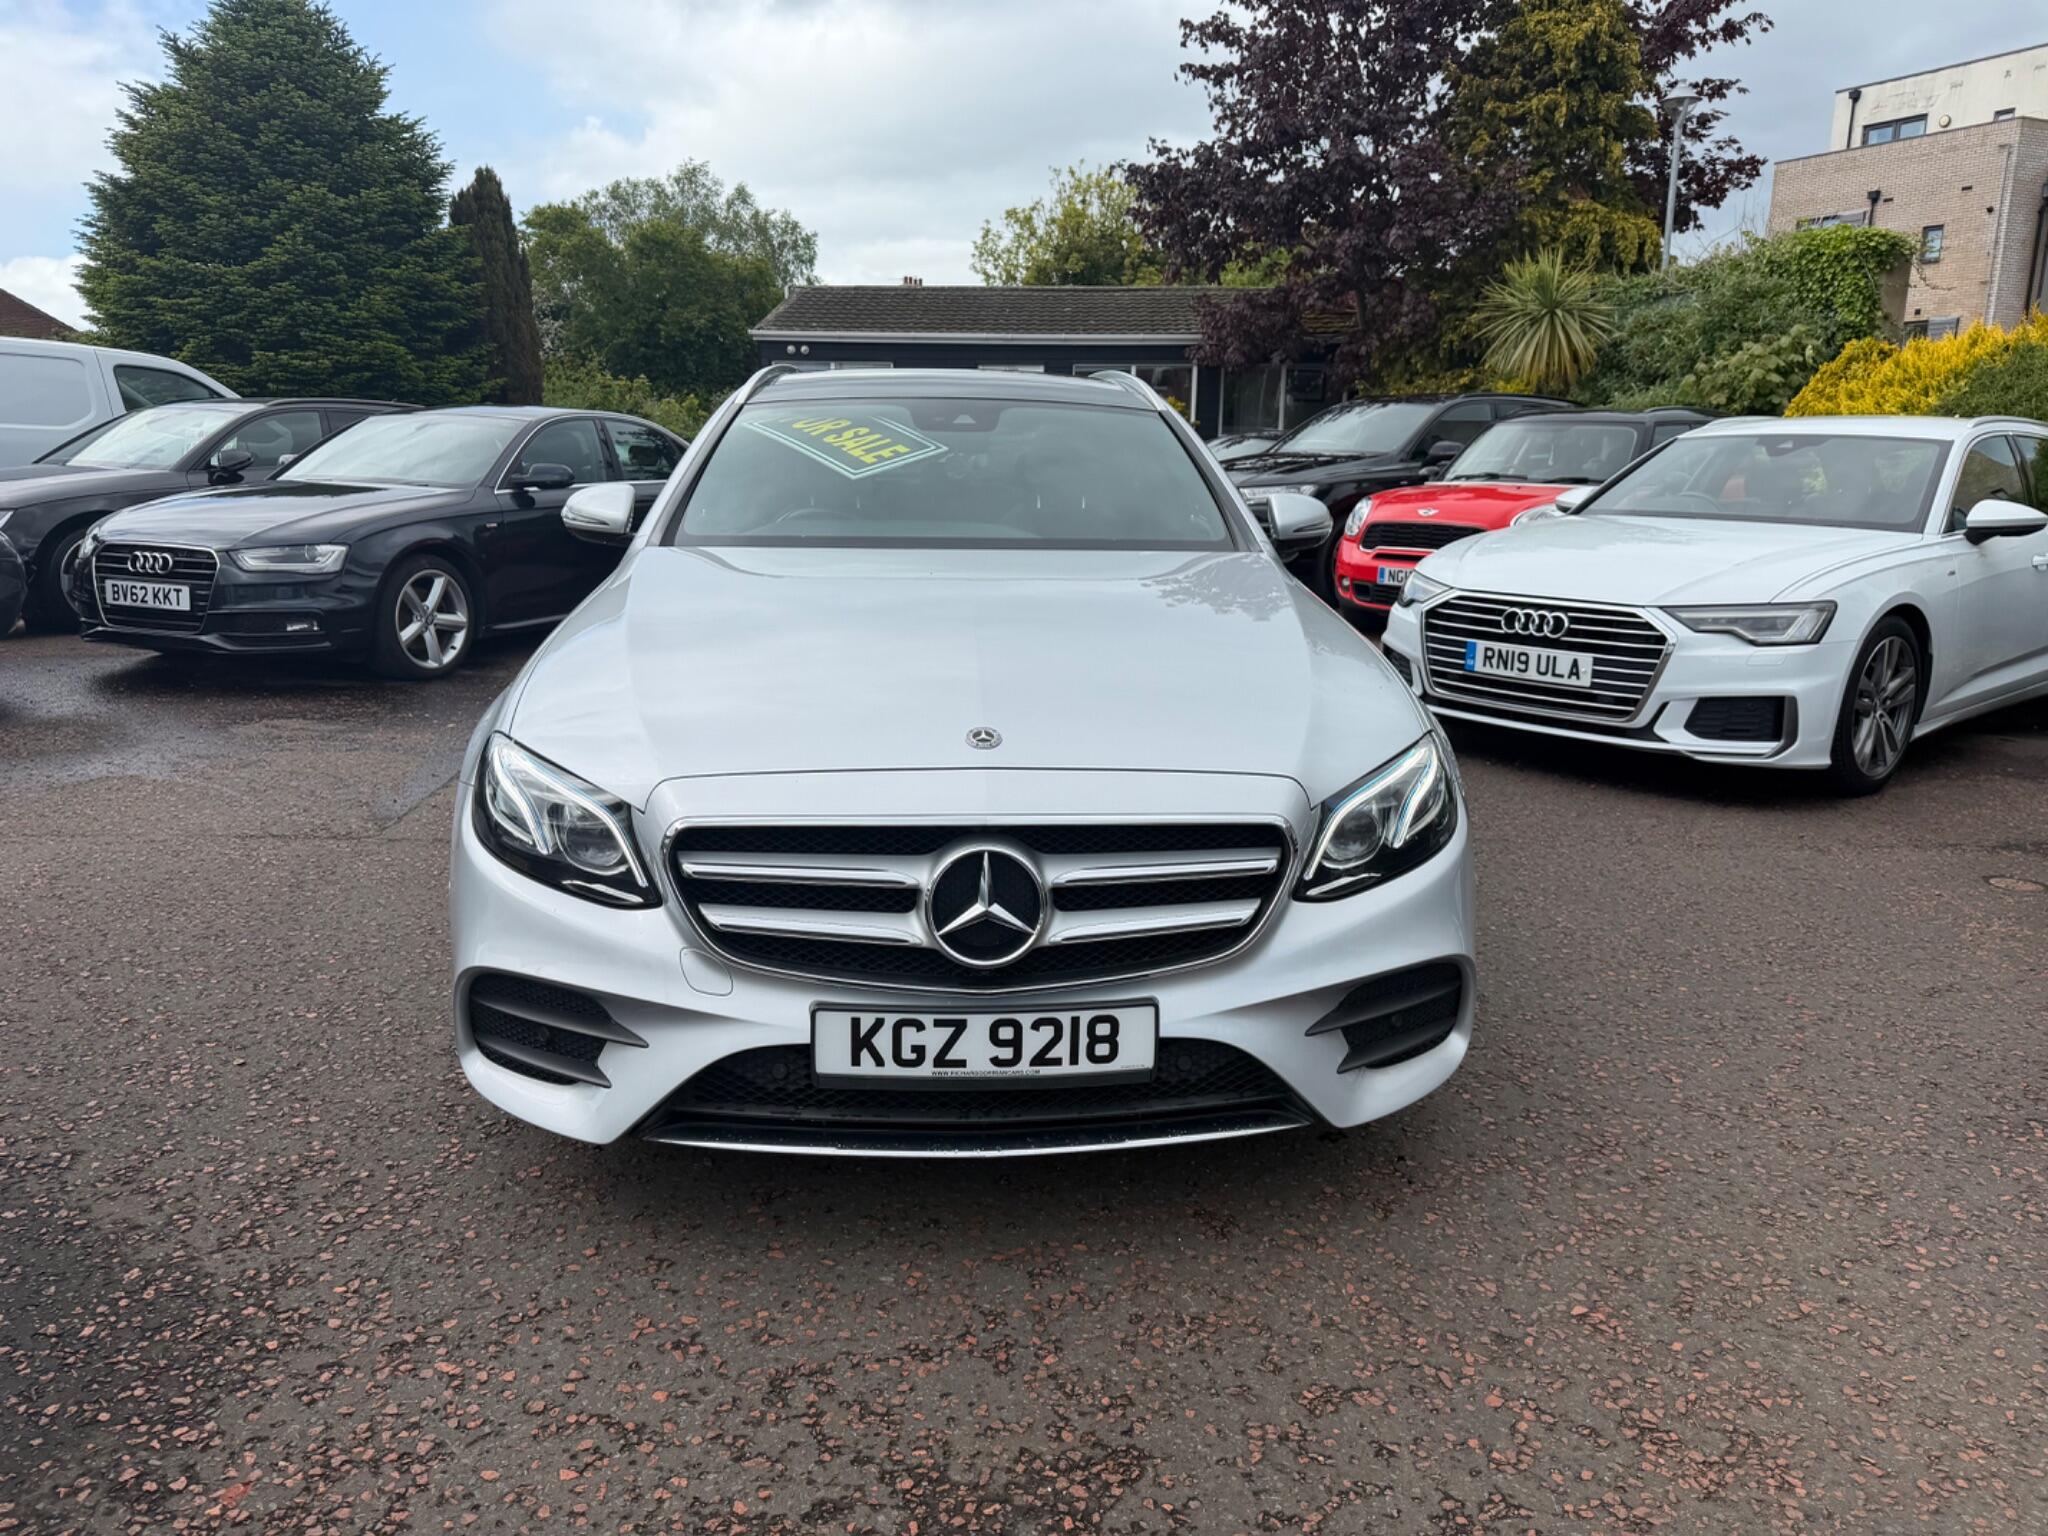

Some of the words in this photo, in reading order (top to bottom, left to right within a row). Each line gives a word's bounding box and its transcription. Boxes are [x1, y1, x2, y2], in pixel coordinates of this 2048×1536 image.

[823, 426, 911, 464] SALE
[111, 583, 149, 603] BV62
[152, 586, 183, 606] KKT
[1482, 646, 1530, 673] RN19
[1536, 653, 1581, 680] ULA
[850, 1016, 968, 1069] KGZ
[988, 1014, 1120, 1068] 9218
